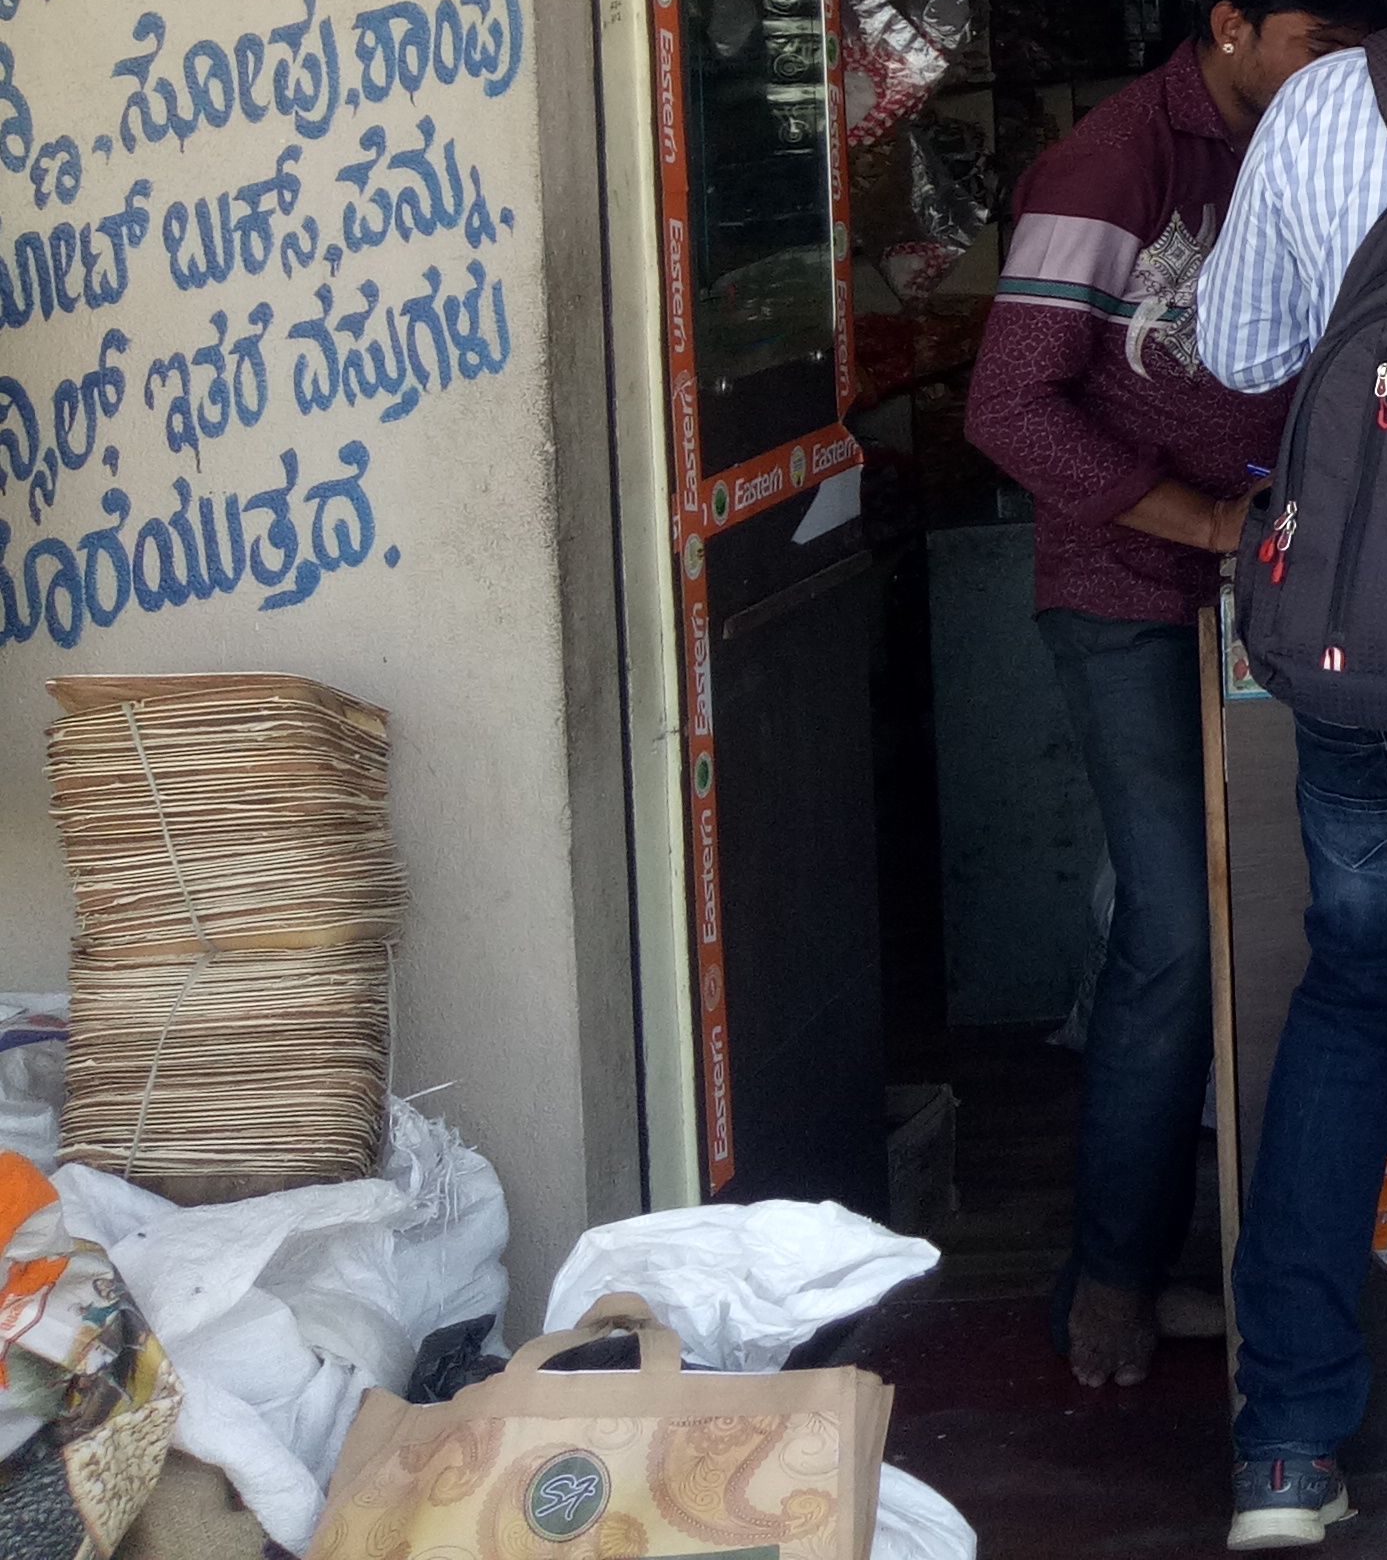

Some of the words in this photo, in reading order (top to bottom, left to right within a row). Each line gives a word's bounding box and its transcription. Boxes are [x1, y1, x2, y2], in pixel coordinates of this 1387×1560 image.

[656, 29, 676, 164] Eastern
[669, 219, 687, 354] Eastern
[734, 467, 783, 510] Eastern
[702, 808, 717, 943] Eastern
[713, 1025, 729, 1162] Eastern
